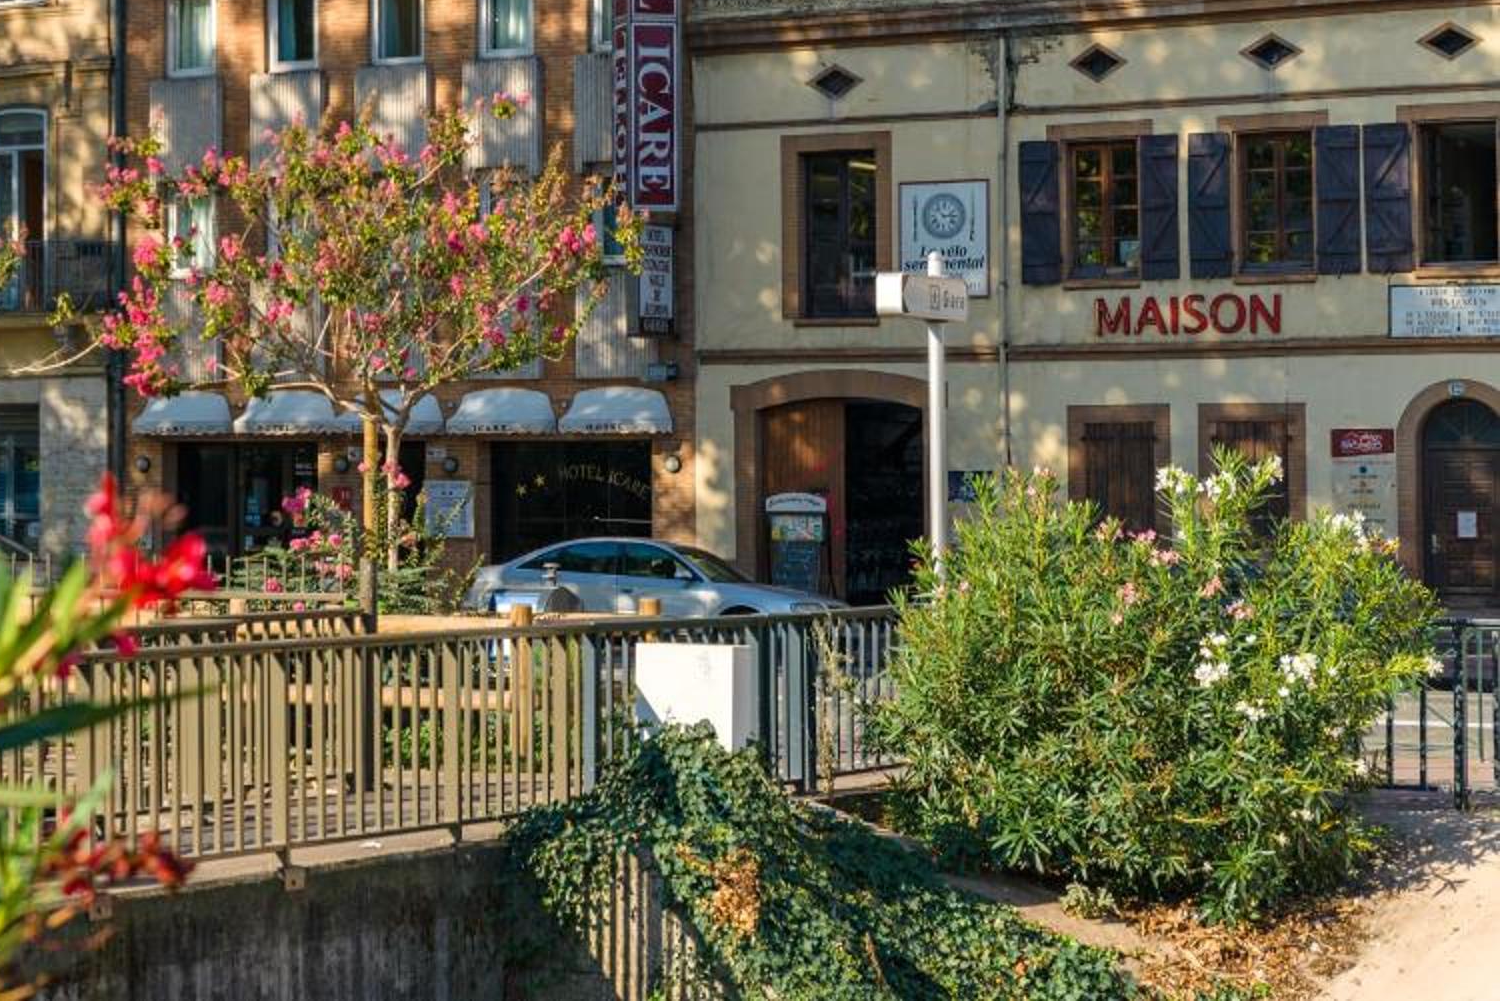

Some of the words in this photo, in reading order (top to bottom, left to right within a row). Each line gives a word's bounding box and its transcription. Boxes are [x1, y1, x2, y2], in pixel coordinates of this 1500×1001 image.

[638, 46, 671, 191] ICARE
[1094, 293, 1282, 336] MAISON
[558, 462, 604, 482] HOTEL
